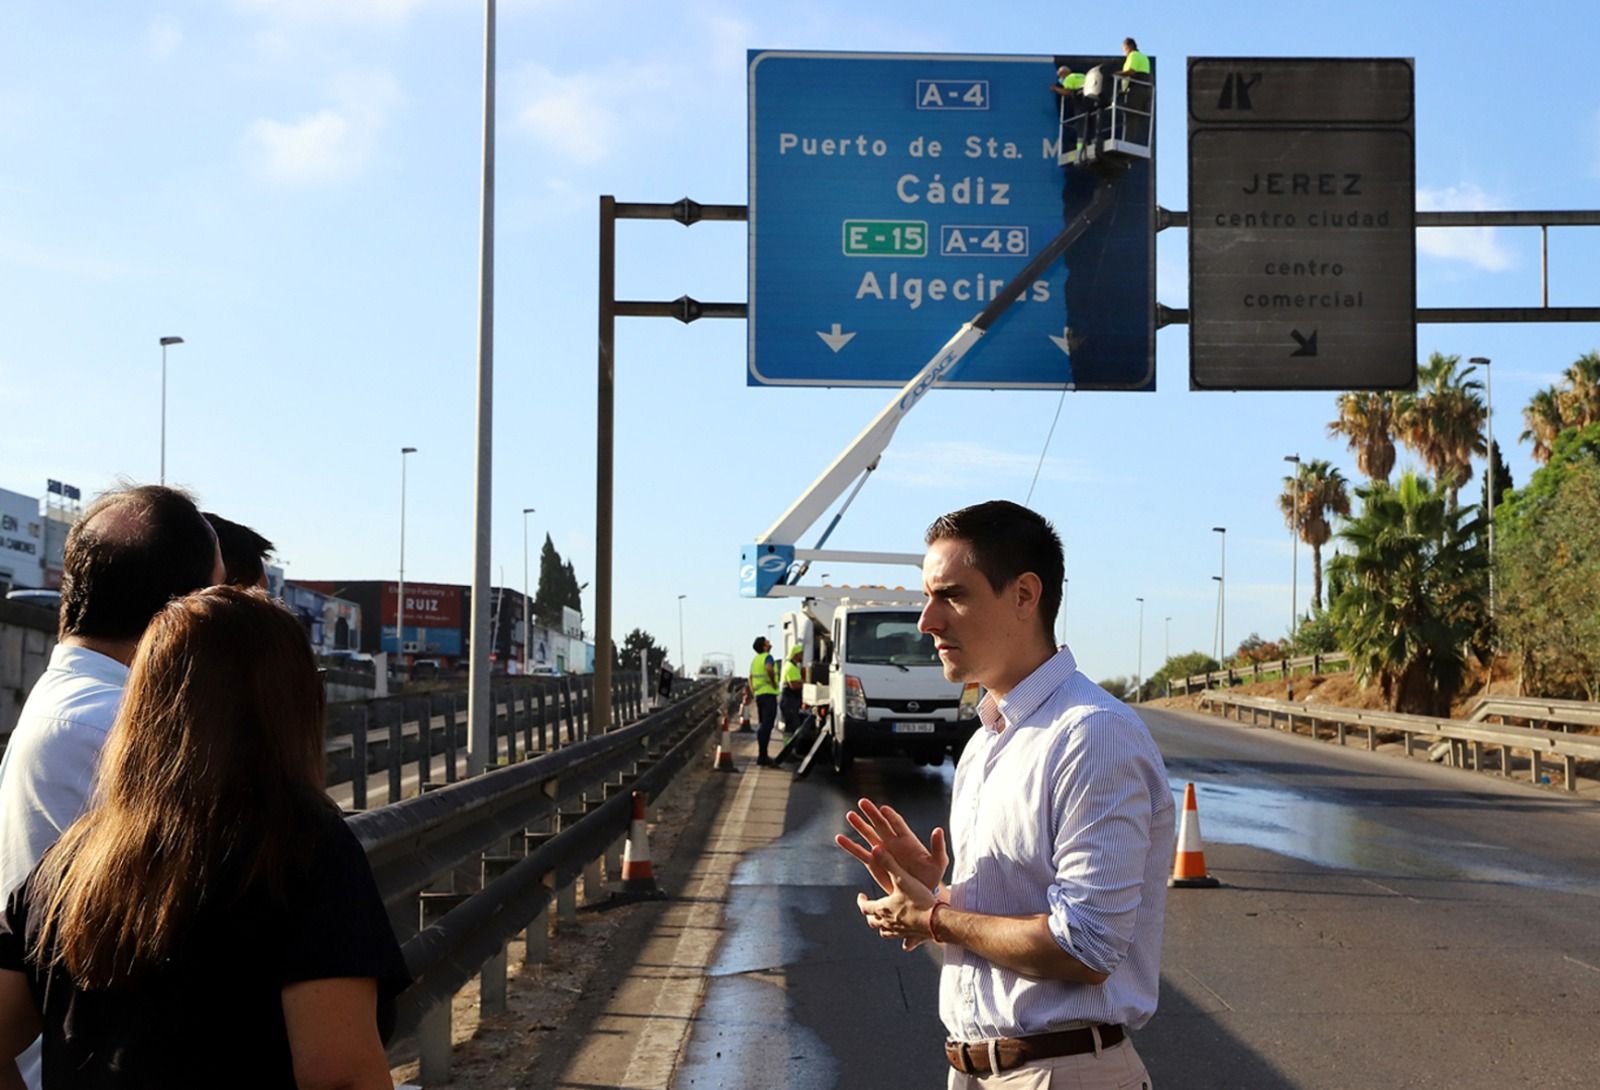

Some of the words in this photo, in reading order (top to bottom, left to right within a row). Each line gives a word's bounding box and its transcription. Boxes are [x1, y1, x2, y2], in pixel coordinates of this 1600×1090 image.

[780, 133, 887, 157] Puerto
[909, 136, 942, 157] de
[965, 136, 1023, 159] Sta.
[896, 174, 1010, 205] Cádiz
[1242, 173, 1363, 196] JEREZ
[1215, 210, 1297, 228] centro
[1307, 207, 1391, 228] ciudad
[1264, 259, 1344, 277] centro
[1243, 291, 1364, 309] comercial
[405, 597, 439, 612] RUIZ
